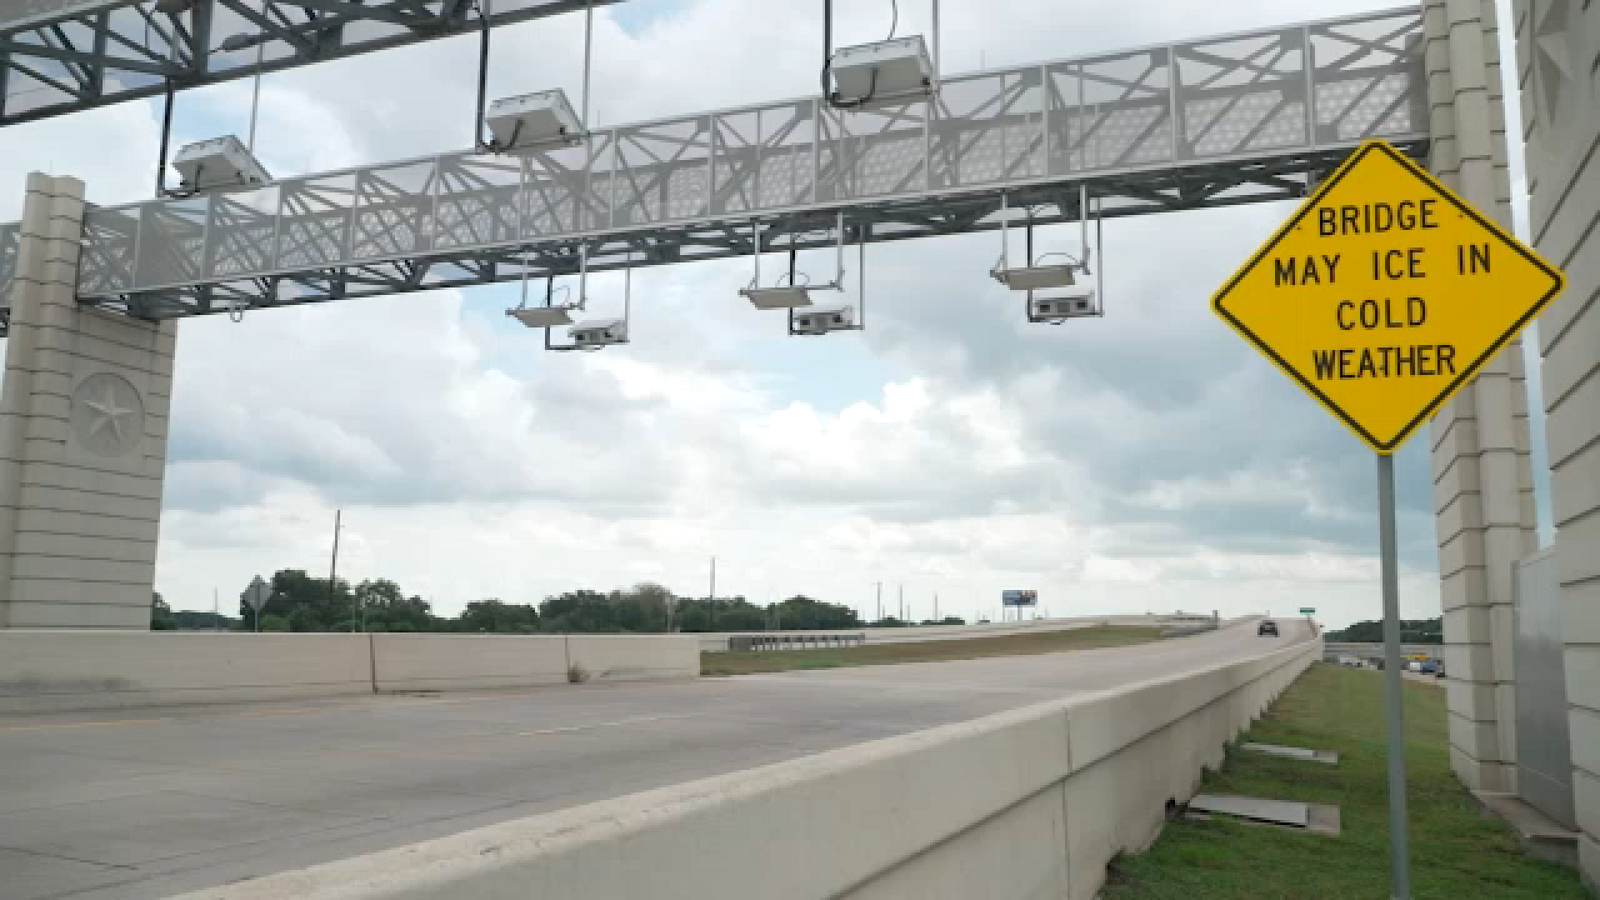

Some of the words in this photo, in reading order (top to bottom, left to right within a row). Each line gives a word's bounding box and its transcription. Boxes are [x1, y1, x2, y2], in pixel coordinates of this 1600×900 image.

[1318, 199, 1439, 236] BRIDGE
[1274, 254, 1341, 286] MAY
[1373, 248, 1426, 281] ICE
[1458, 243, 1491, 276] IN
[1337, 296, 1426, 331] COLD
[1313, 345, 1456, 380] WEATHER
